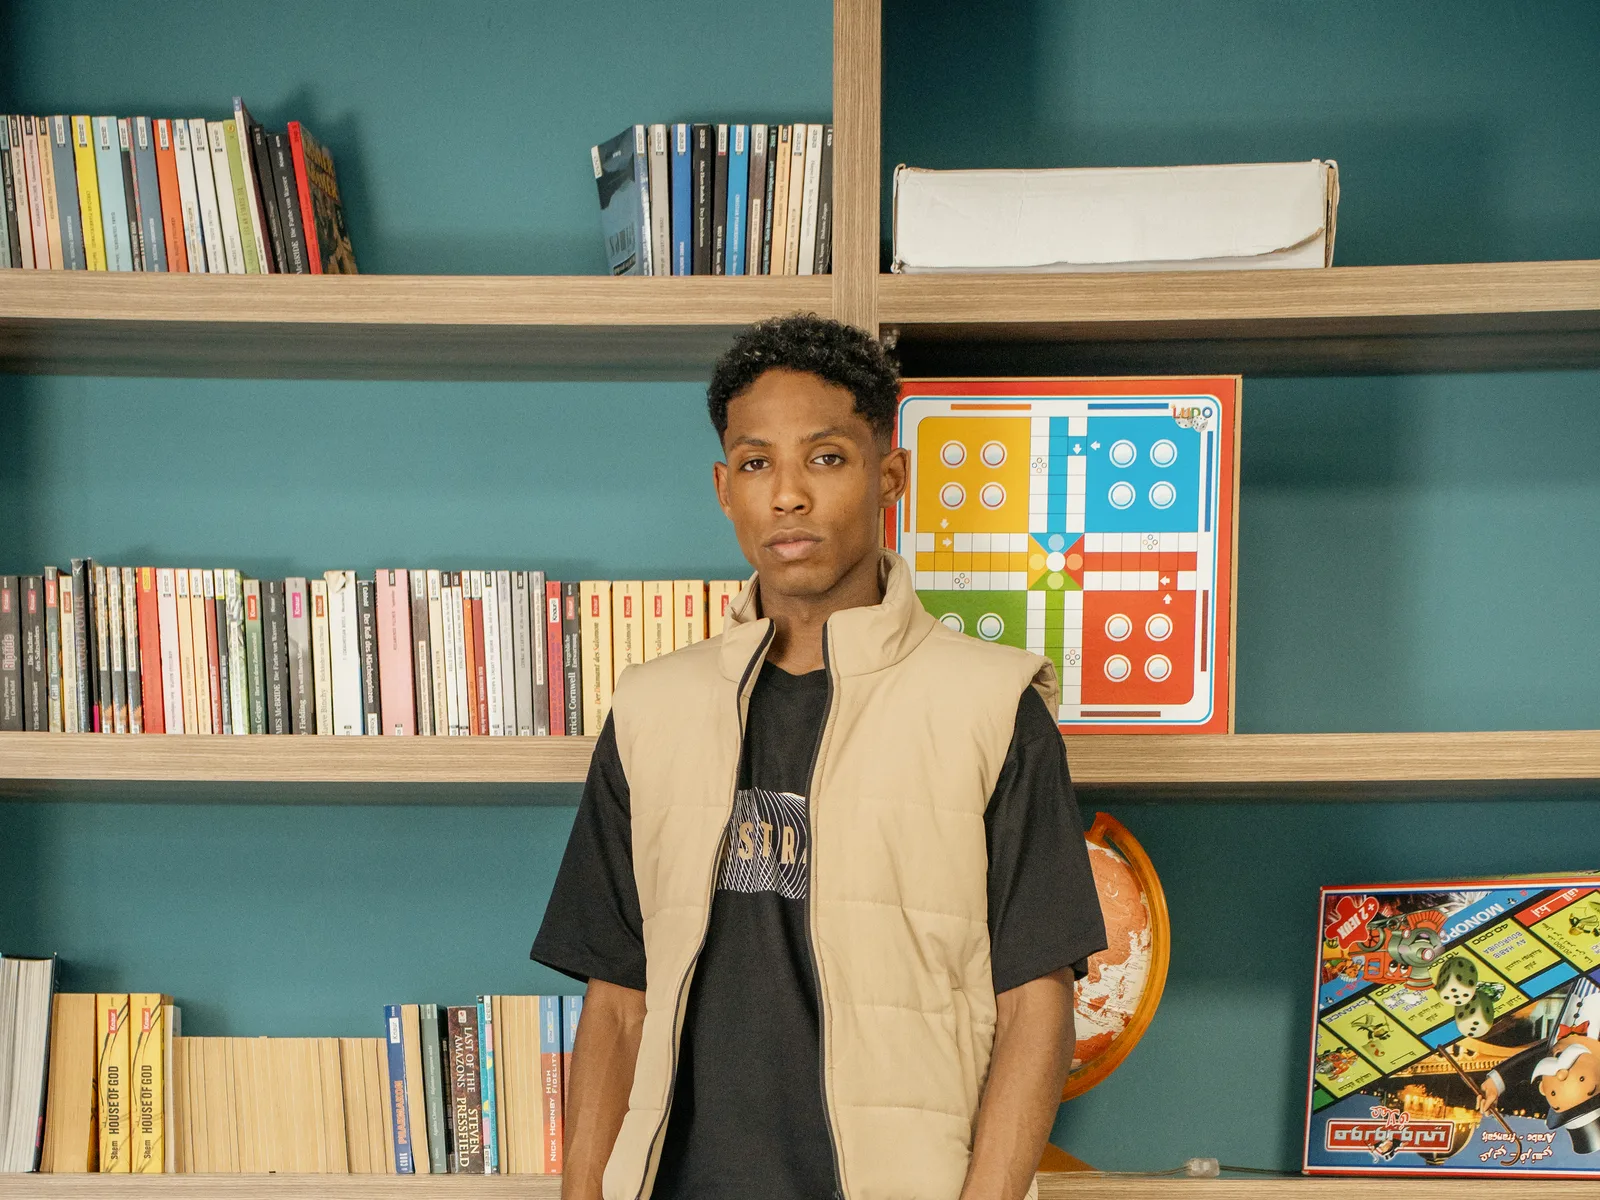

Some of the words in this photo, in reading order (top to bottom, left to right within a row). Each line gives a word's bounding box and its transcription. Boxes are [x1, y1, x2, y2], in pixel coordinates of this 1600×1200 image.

[1171, 404, 1213, 419] LUDO
[74, 596, 84, 633] POWER
[3, 634, 16, 670] Riptide
[75, 638, 86, 671] WORD
[366, 654, 374, 703] Märchenprinzen
[273, 684, 282, 717] McBRIDE
[320, 689, 329, 713] Binchy
[568, 672, 577, 710] Cornwell
[255, 700, 263, 723] Geiger
[298, 699, 306, 729] Fielding
[1358, 907, 1369, 919] 2
[1337, 914, 1360, 938] JEUX
[1492, 944, 1514, 958] HABIB
[1325, 1000, 1367, 1023] CHANCE
[391, 1021, 399, 1040] Knaur
[464, 1027, 474, 1052] LAST
[454, 1035, 465, 1089] AMAZONS
[465, 1054, 475, 1069] OF
[108, 1066, 119, 1086] GOD
[141, 1065, 152, 1085] GOD
[466, 1072, 475, 1093] THE
[108, 1088, 119, 1100] OF
[141, 1086, 152, 1098] OF
[108, 1102, 119, 1135] HOUSE
[141, 1101, 152, 1133] HOUSE
[394, 1080, 407, 1144] PHARMAKON
[456, 1097, 469, 1167] PRESSFIELD
[468, 1108, 480, 1154] STEVEN
[1527, 1132, 1556, 1142] Arabe
[110, 1141, 118, 1160] Shem
[143, 1140, 151, 1159] Shem
[399, 1152, 408, 1167] COOK
[1479, 1145, 1507, 1162] عربي
